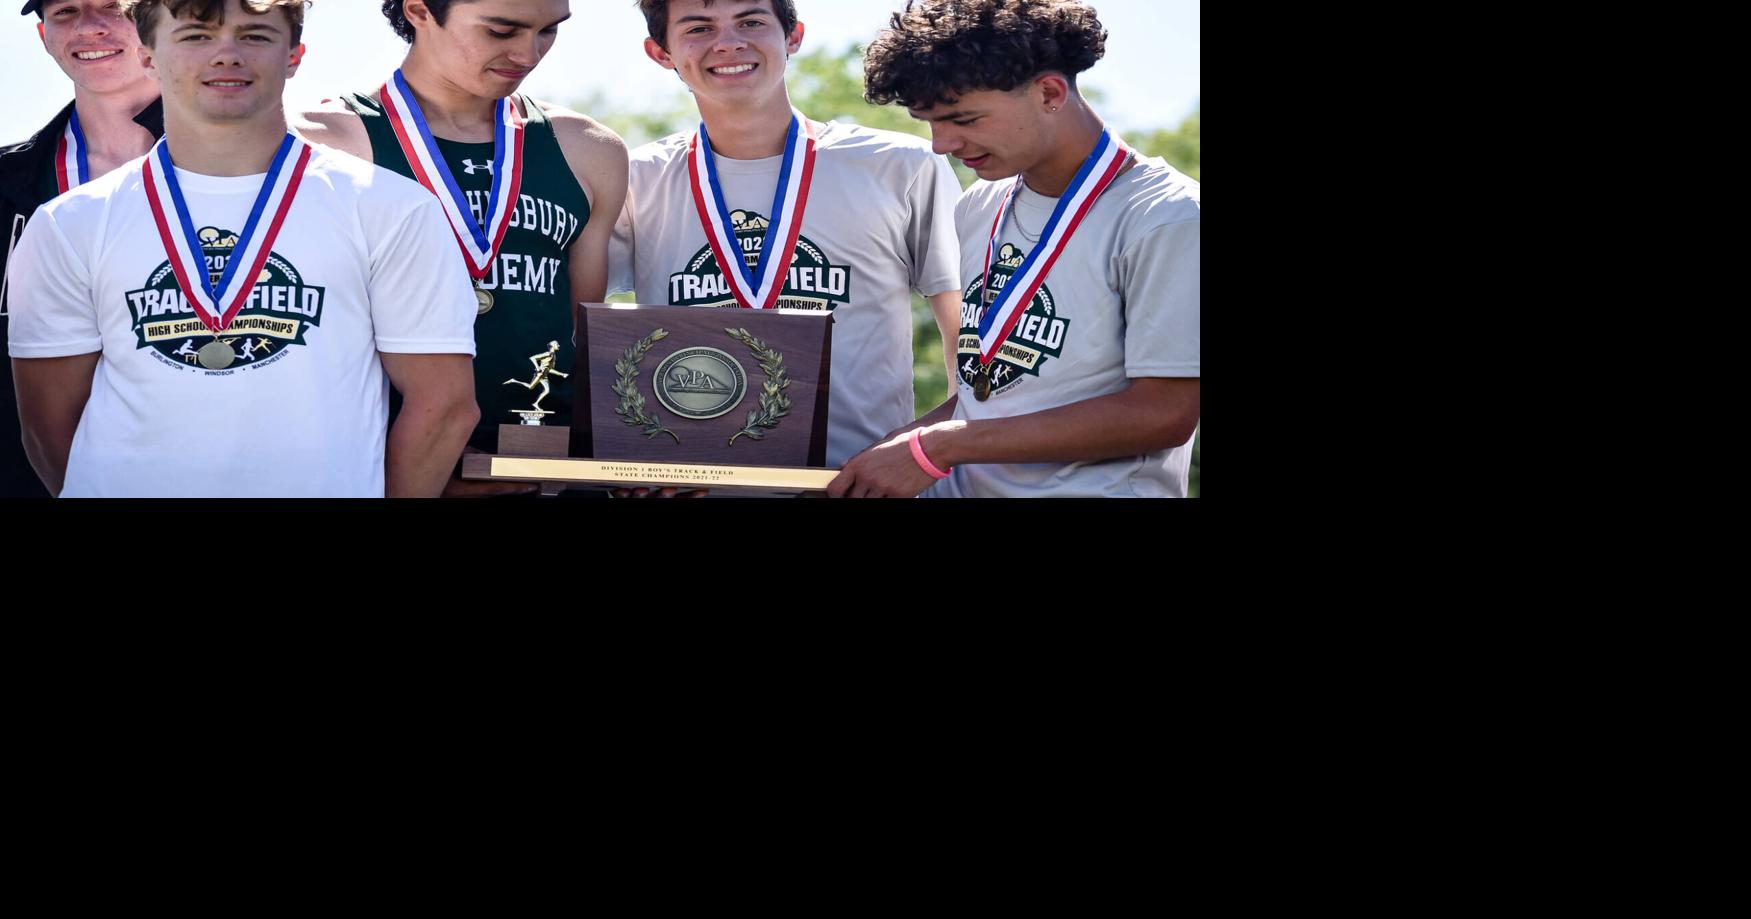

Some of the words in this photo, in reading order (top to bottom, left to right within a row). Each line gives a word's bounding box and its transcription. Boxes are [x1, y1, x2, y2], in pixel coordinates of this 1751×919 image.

[479, 253, 561, 295] DEMY
[671, 274, 731, 303] TRAC
[785, 267, 846, 296] IELD
[148, 325, 171, 337] HIGH
[174, 321, 208, 333] SCHOO
[228, 318, 294, 334] AMPIONSHIPS
[1015, 313, 1065, 350] IELD
[252, 349, 290, 369] MANCHESTER
[678, 370, 714, 389] VPA
